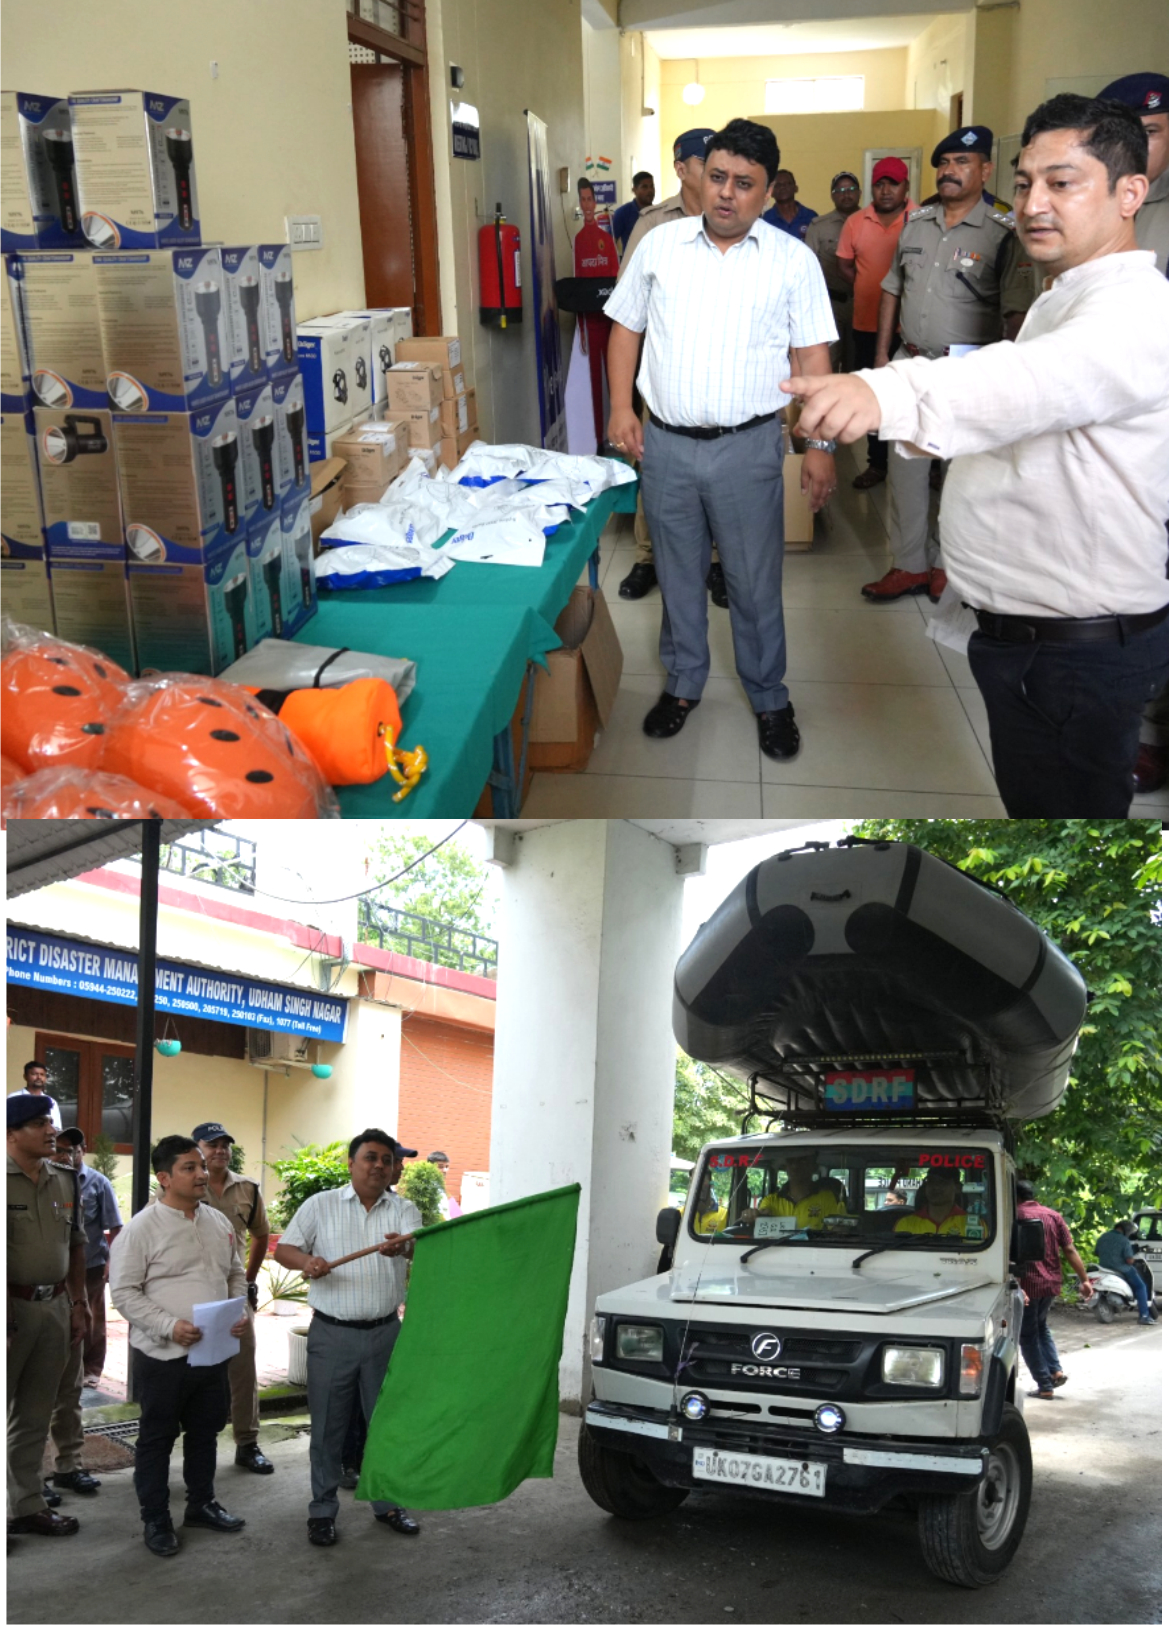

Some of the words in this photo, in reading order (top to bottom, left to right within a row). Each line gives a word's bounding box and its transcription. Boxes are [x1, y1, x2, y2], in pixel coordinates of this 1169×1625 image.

[33, 971, 72, 988] Numbers
[39, 943, 101, 977] DISASTER
[103, 957, 185, 993] MANAMENT
[185, 975, 246, 1009] AUTHORITY,
[248, 987, 283, 1012] UDHAM
[284, 994, 312, 1018] SINGH
[312, 1001, 343, 1025] NAGAR
[832, 1076, 907, 1104] SDRF
[918, 1153, 986, 1169] POLICE
[730, 1362, 801, 1380] FORCE
